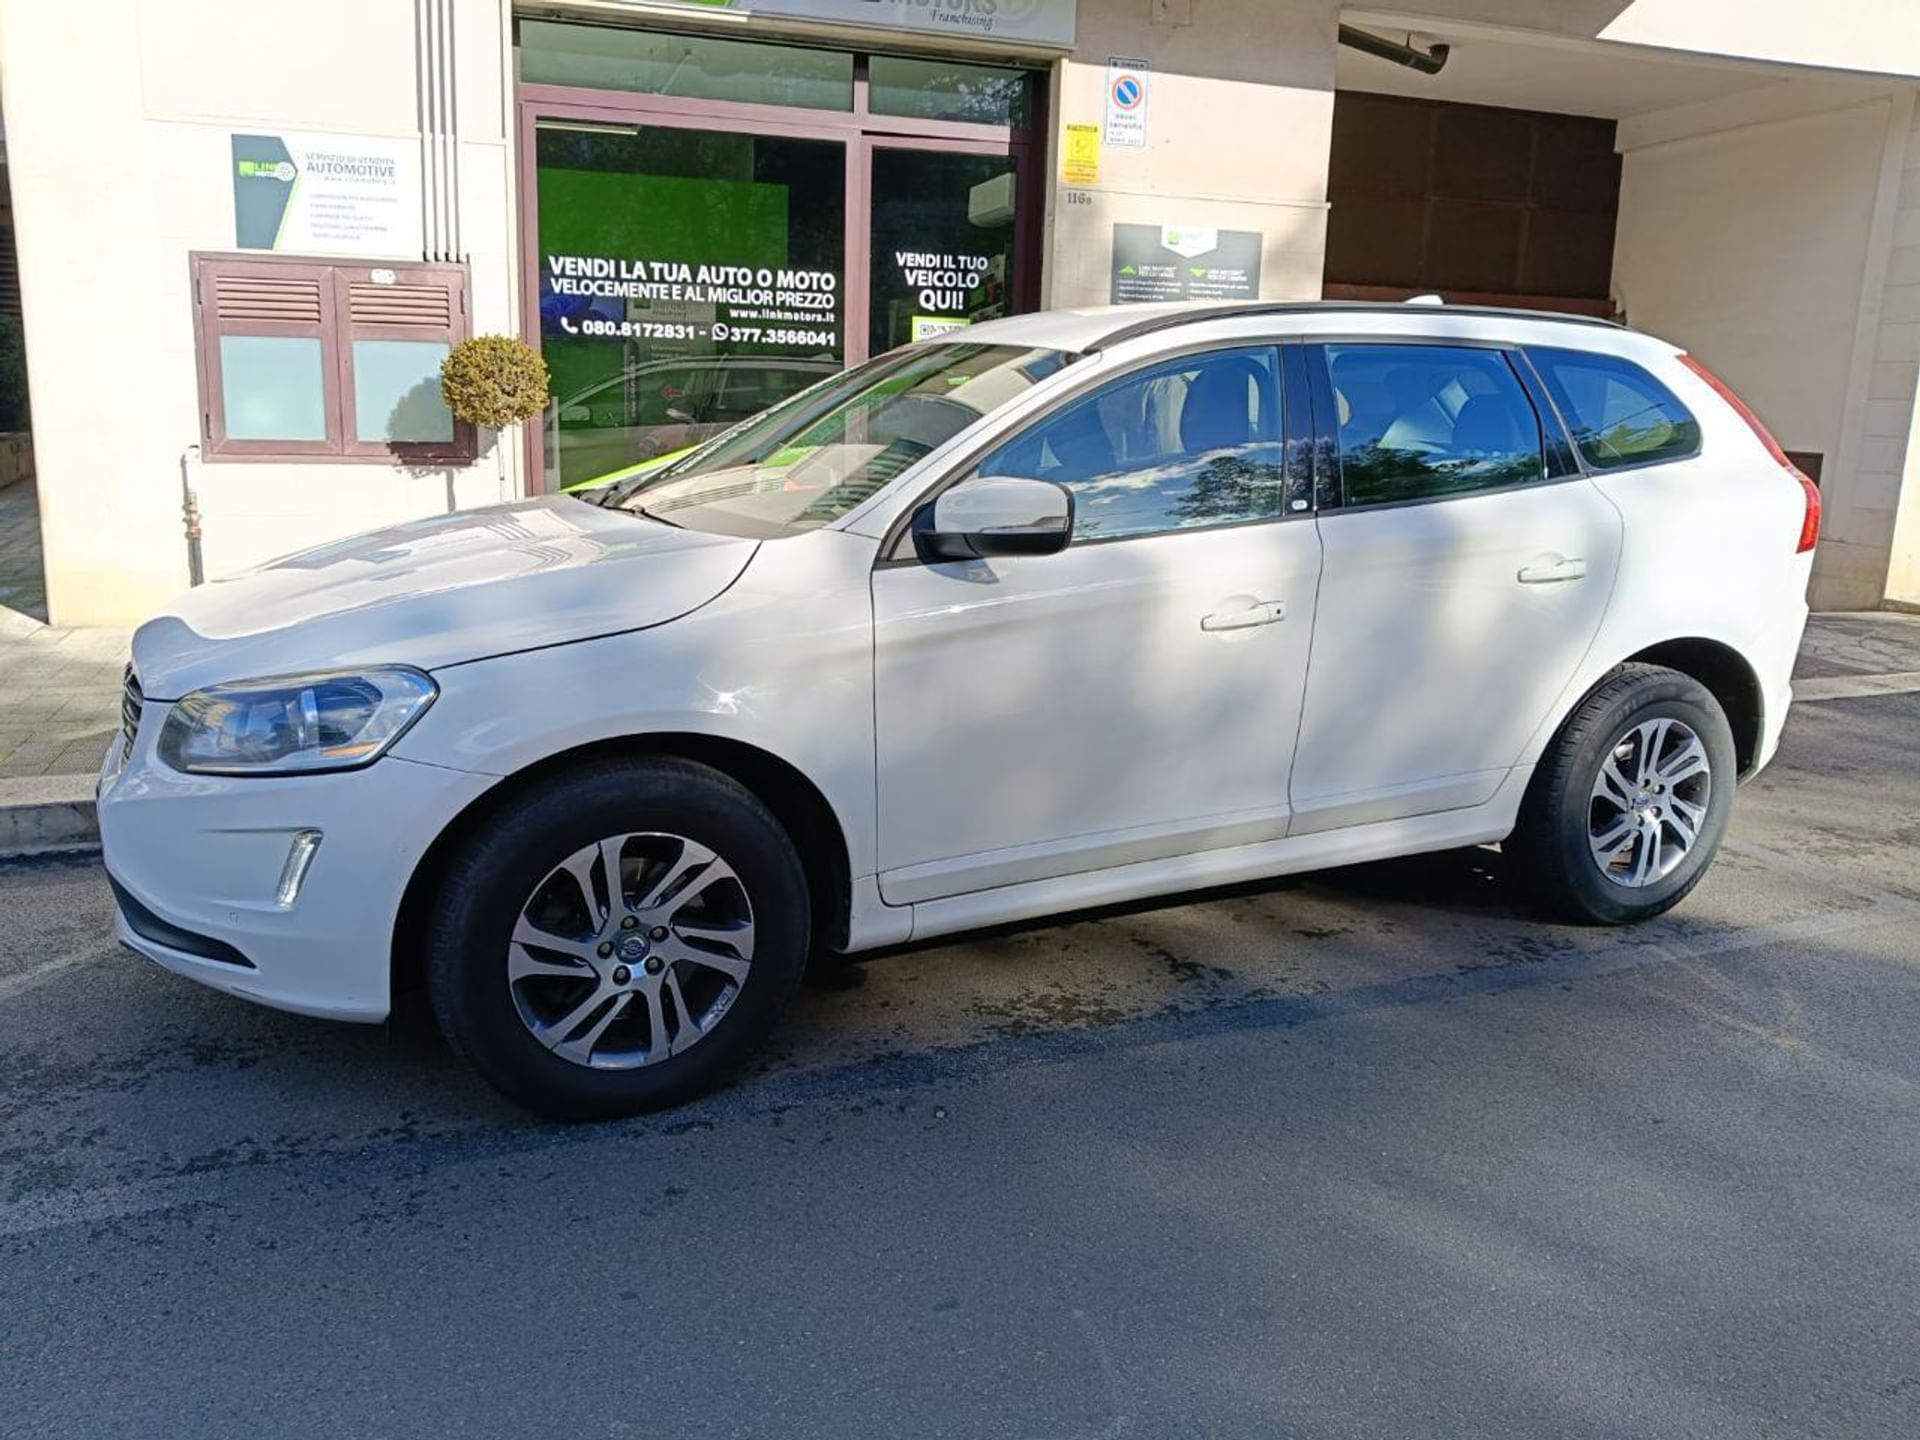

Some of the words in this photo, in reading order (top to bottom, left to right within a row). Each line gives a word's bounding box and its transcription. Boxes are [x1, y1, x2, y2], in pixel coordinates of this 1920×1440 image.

[929, 9, 994, 31] Franchising
[306, 162, 396, 177] AUTOMOTIVE
[895, 252, 940, 268] VENDI
[943, 255, 956, 269] IL
[958, 256, 988, 270] TUO
[549, 256, 616, 278] VENDI
[621, 261, 647, 280] LA
[650, 262, 692, 282] TUA
[697, 265, 752, 286] AUTO
[757, 269, 772, 287] O
[777, 270, 836, 291] MOTO
[904, 269, 979, 288] VEICOLO
[551, 278, 669, 299] VELOCEMENTE
[672, 284, 681, 300] E
[684, 285, 704, 301] AL
[708, 287, 773, 306] MIGLIOR
[776, 291, 835, 309] PREZZO
[919, 289, 964, 311] QUI!
[729, 309, 835, 322] www.linkmotors.it
[582, 320, 694, 339] 080.8172831
[731, 327, 835, 346] 377.3566041
